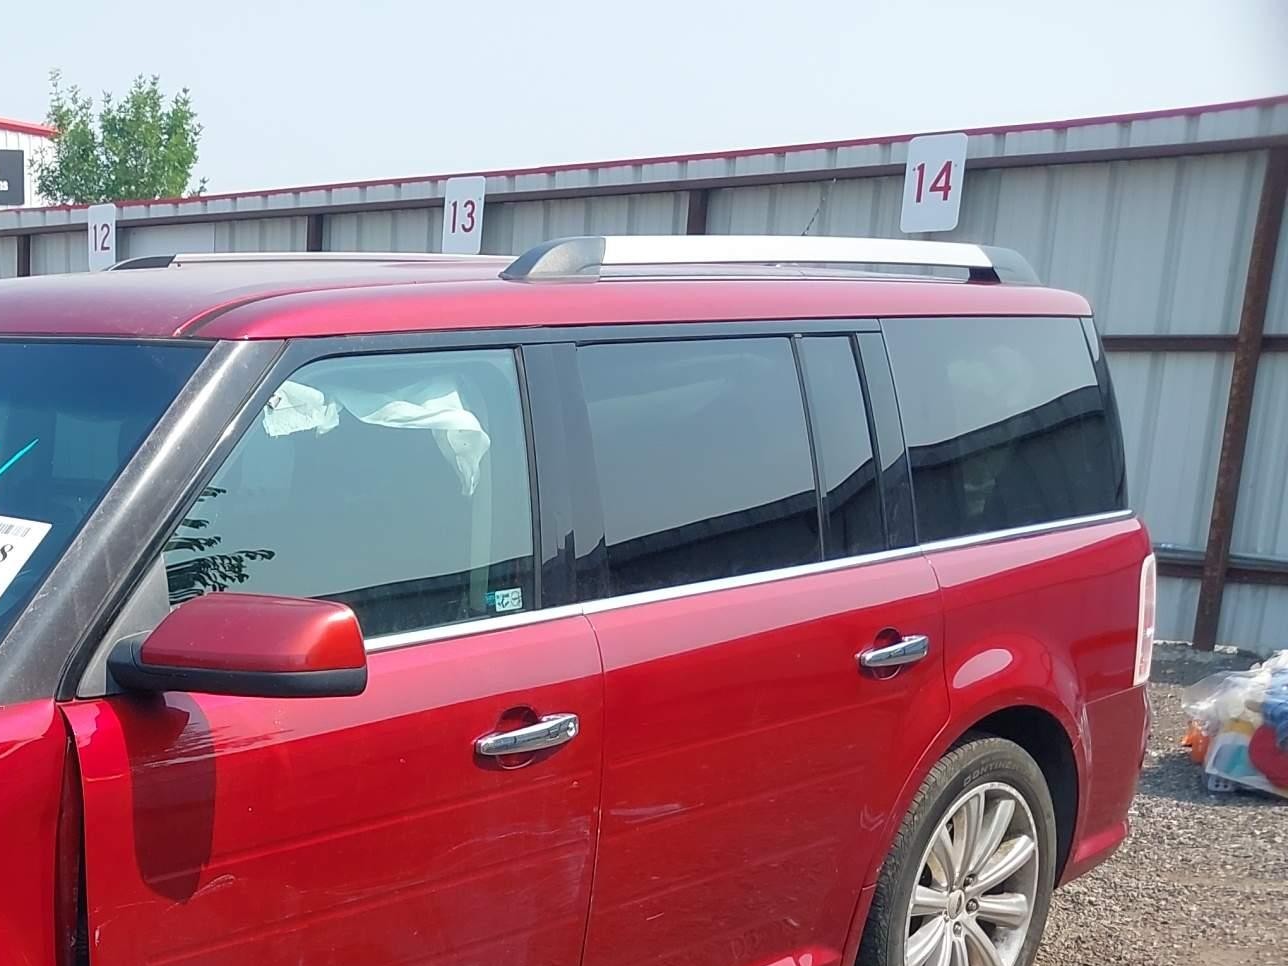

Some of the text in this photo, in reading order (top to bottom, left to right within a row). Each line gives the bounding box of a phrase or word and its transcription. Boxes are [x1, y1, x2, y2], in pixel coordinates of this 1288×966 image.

[913, 160, 954, 204] 14
[448, 199, 476, 234] 13
[91, 223, 111, 252] 12
